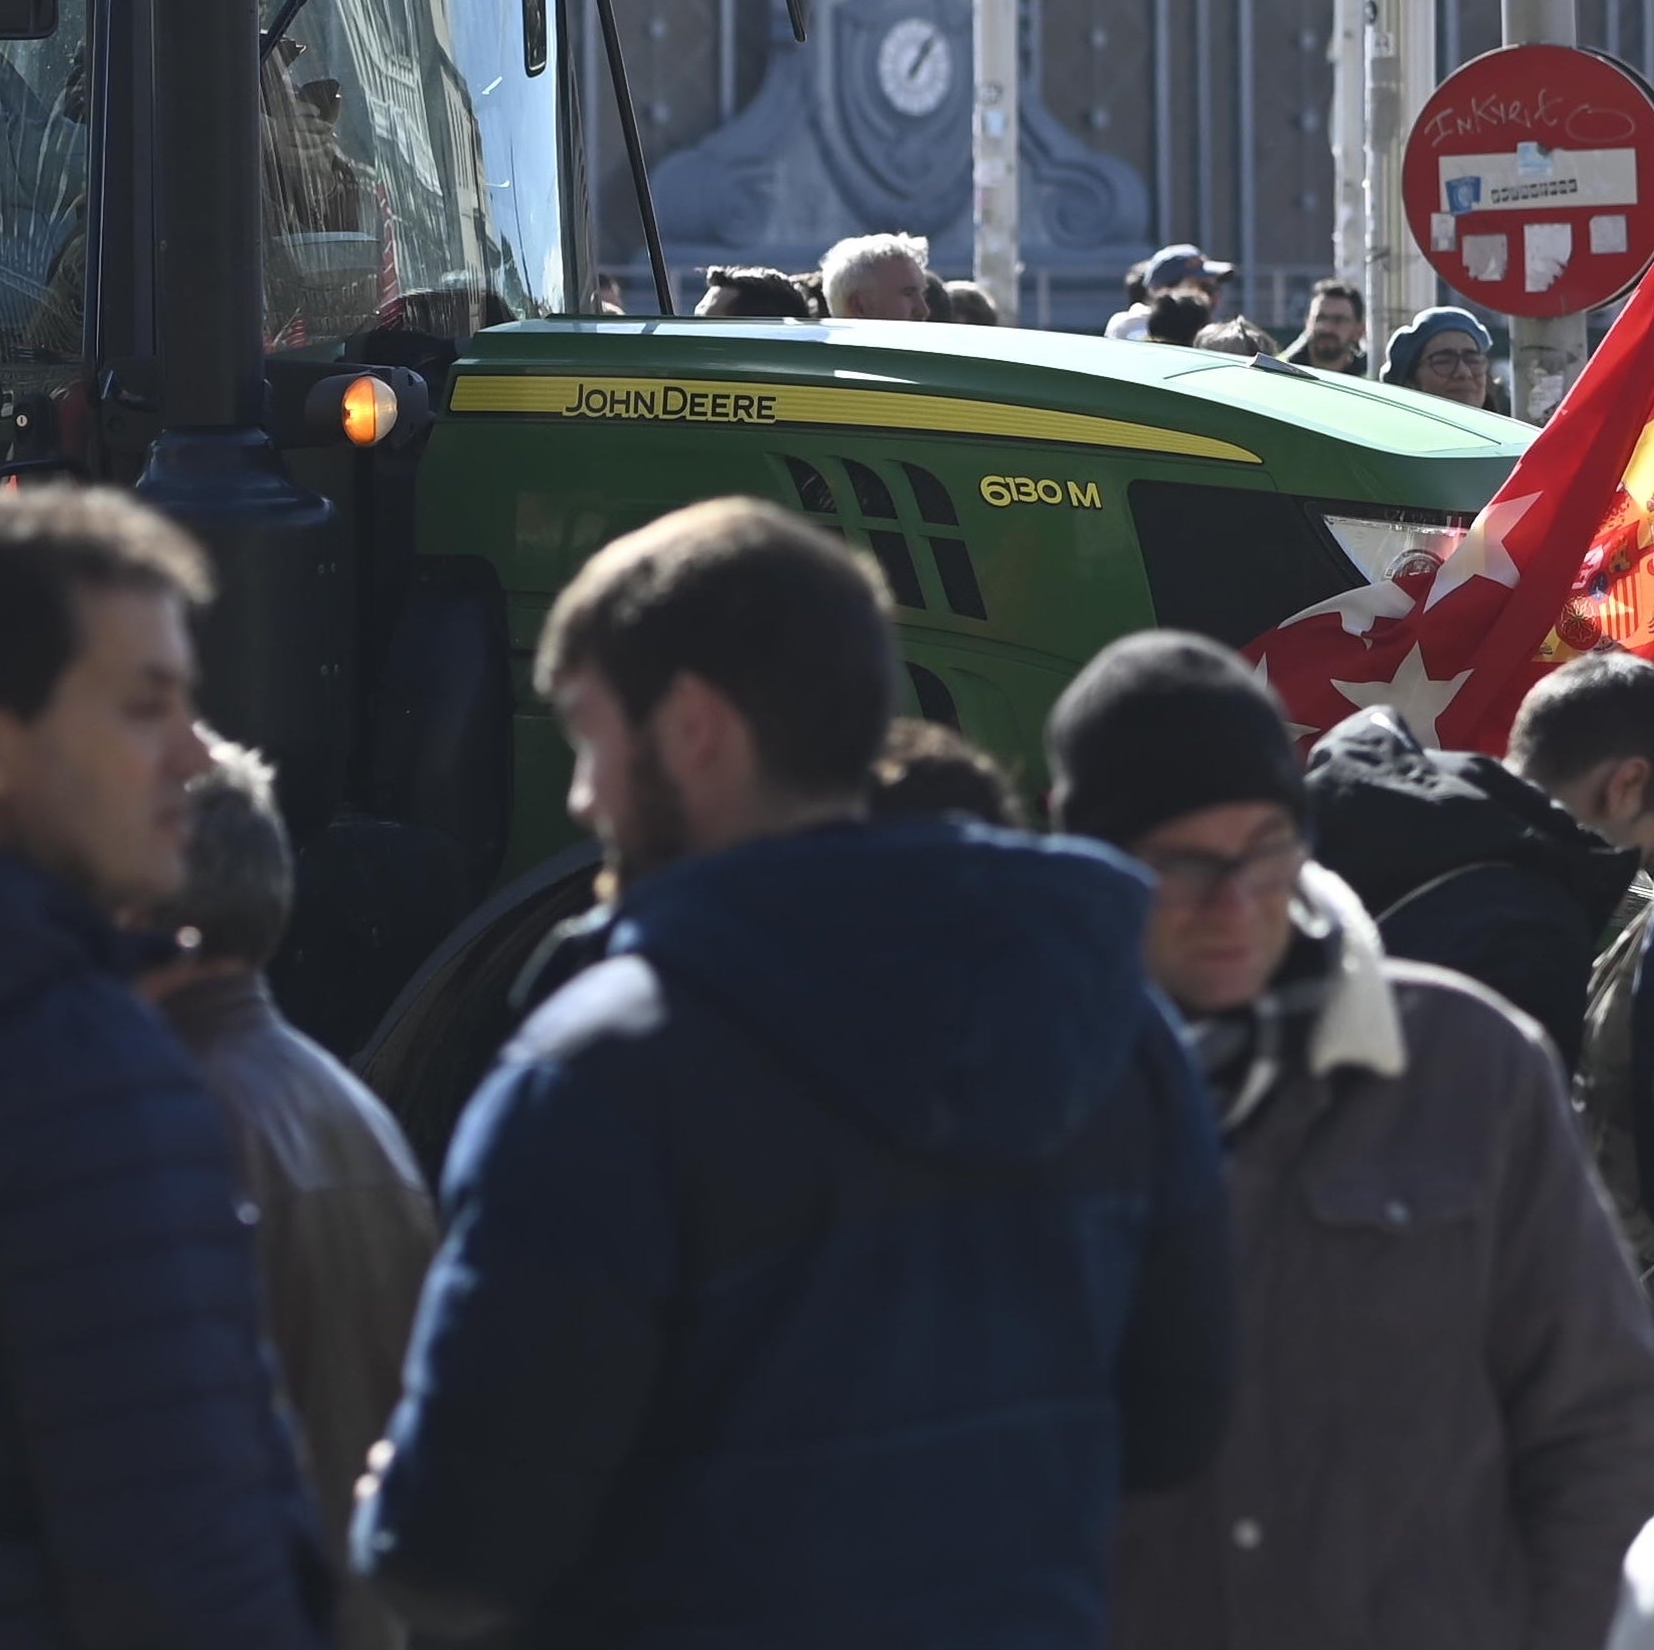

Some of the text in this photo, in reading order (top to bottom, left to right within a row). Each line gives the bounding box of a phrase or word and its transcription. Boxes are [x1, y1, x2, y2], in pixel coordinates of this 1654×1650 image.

[565, 383, 777, 420] JOHN DEERE
[980, 475, 1102, 508] 6130 M
